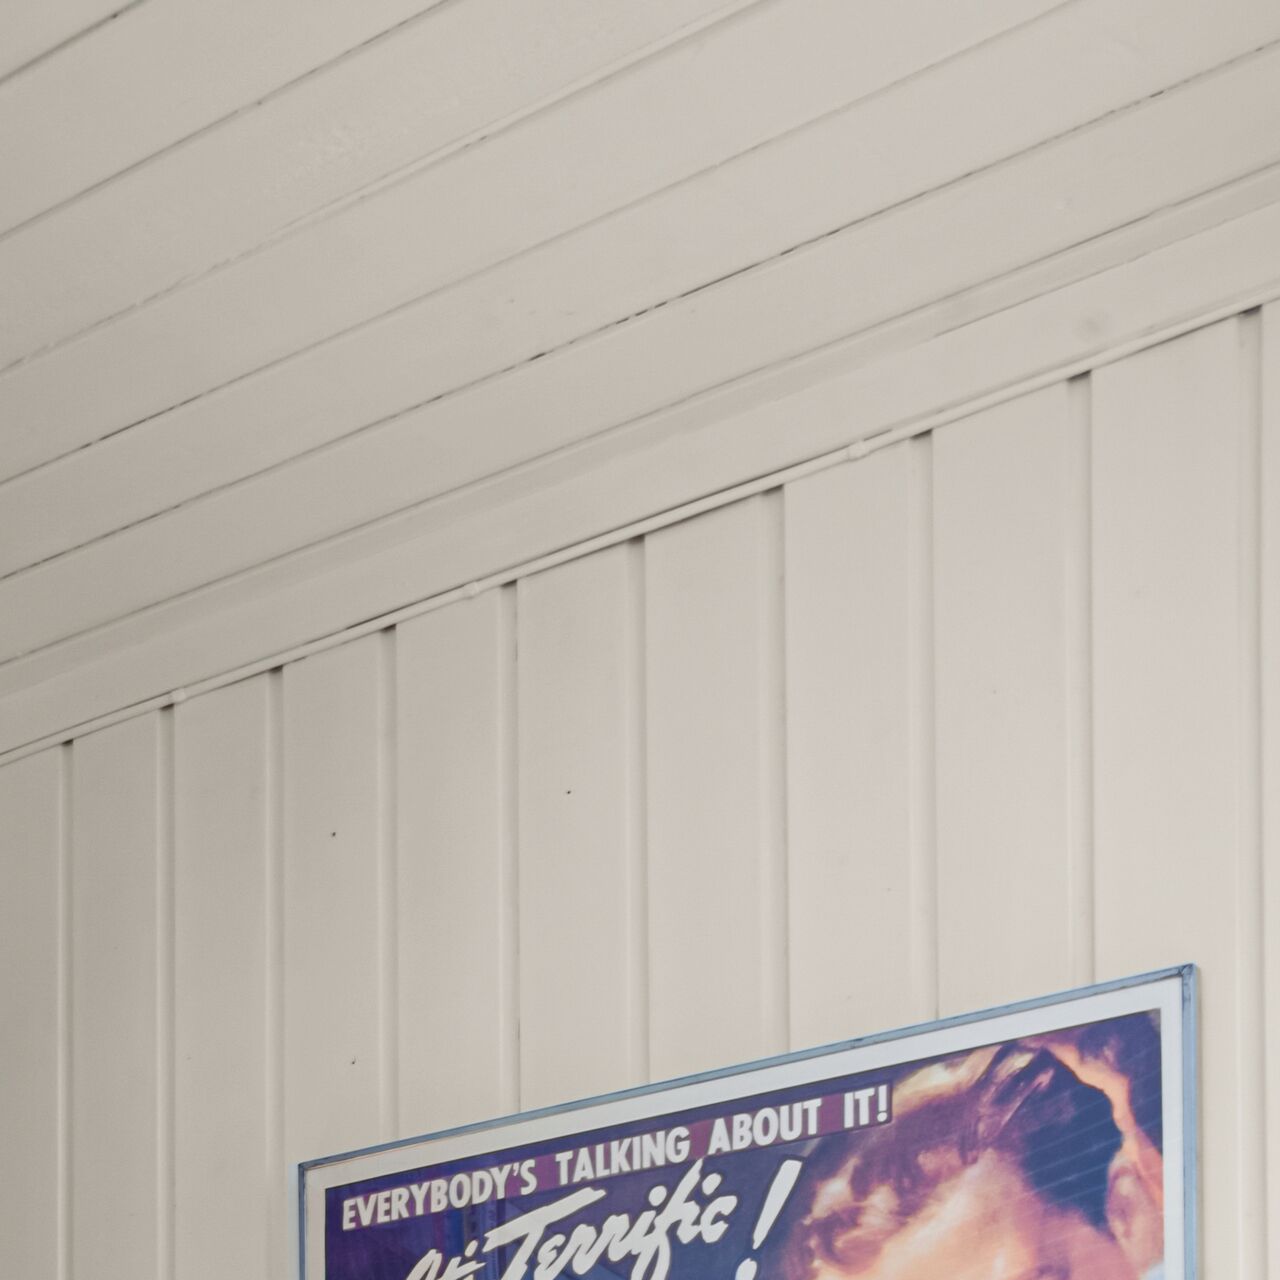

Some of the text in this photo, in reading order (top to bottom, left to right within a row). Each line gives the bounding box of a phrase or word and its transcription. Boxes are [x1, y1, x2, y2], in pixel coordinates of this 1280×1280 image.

[342, 1084, 890, 1231] EVERYBODY'S TALKING ABOUT IT!
